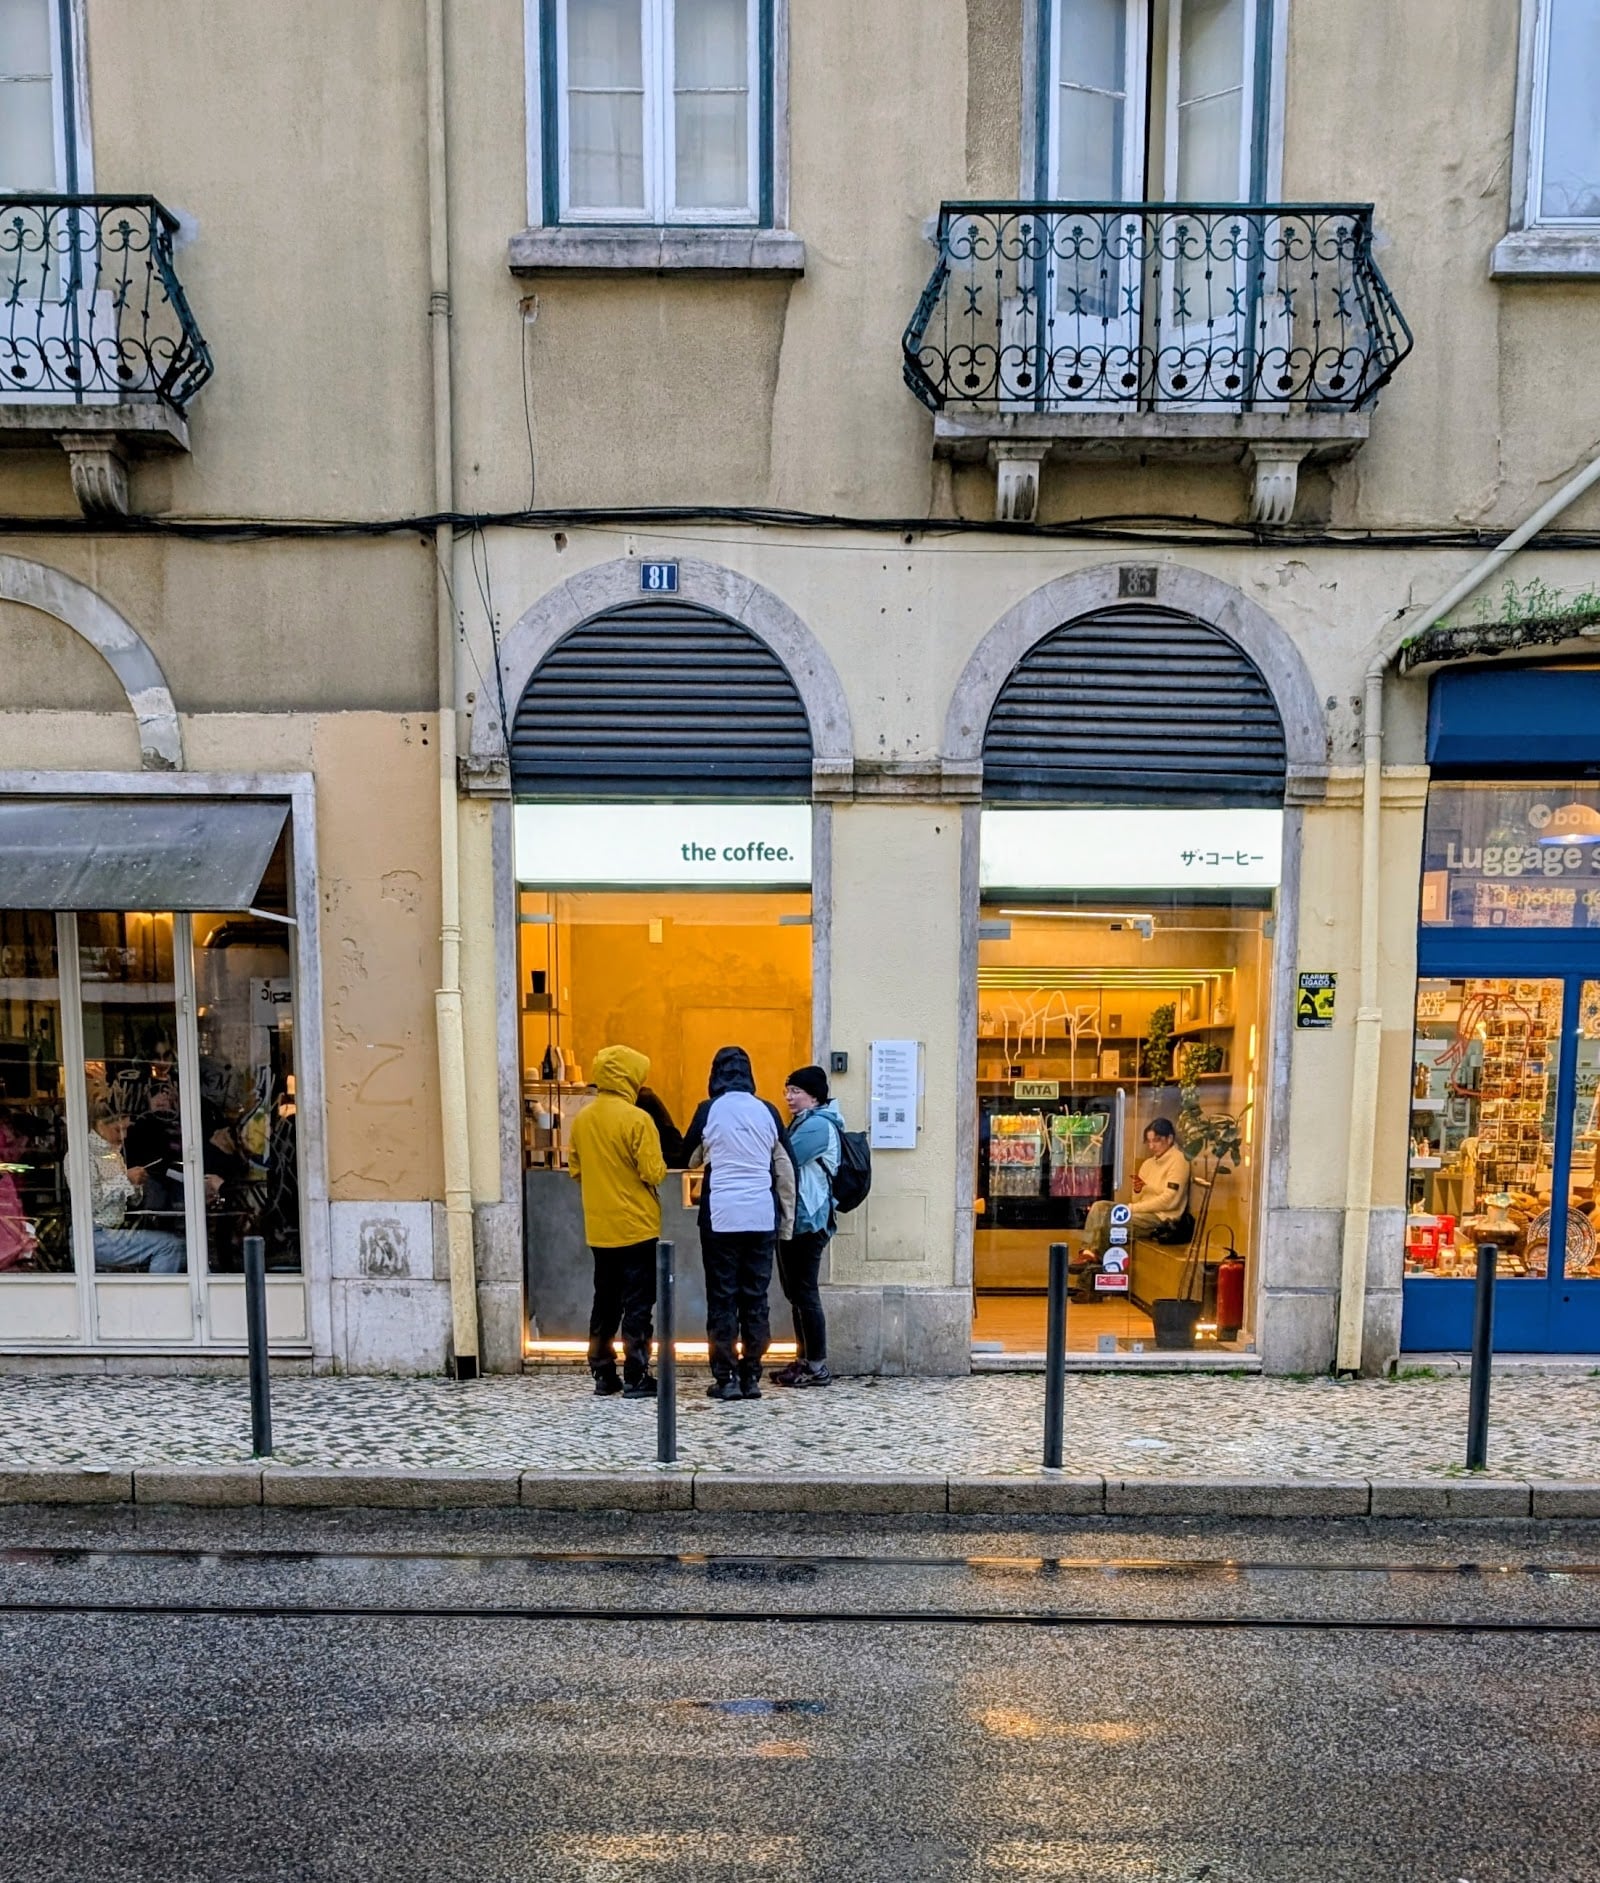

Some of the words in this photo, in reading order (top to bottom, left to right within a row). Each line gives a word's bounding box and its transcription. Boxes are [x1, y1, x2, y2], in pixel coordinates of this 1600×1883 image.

[649, 565, 669, 589] 81
[681, 842, 717, 861] the
[723, 841, 794, 861] coffee.
[1447, 842, 1582, 876] Luggage
[1022, 1085, 1052, 1095] MTA
